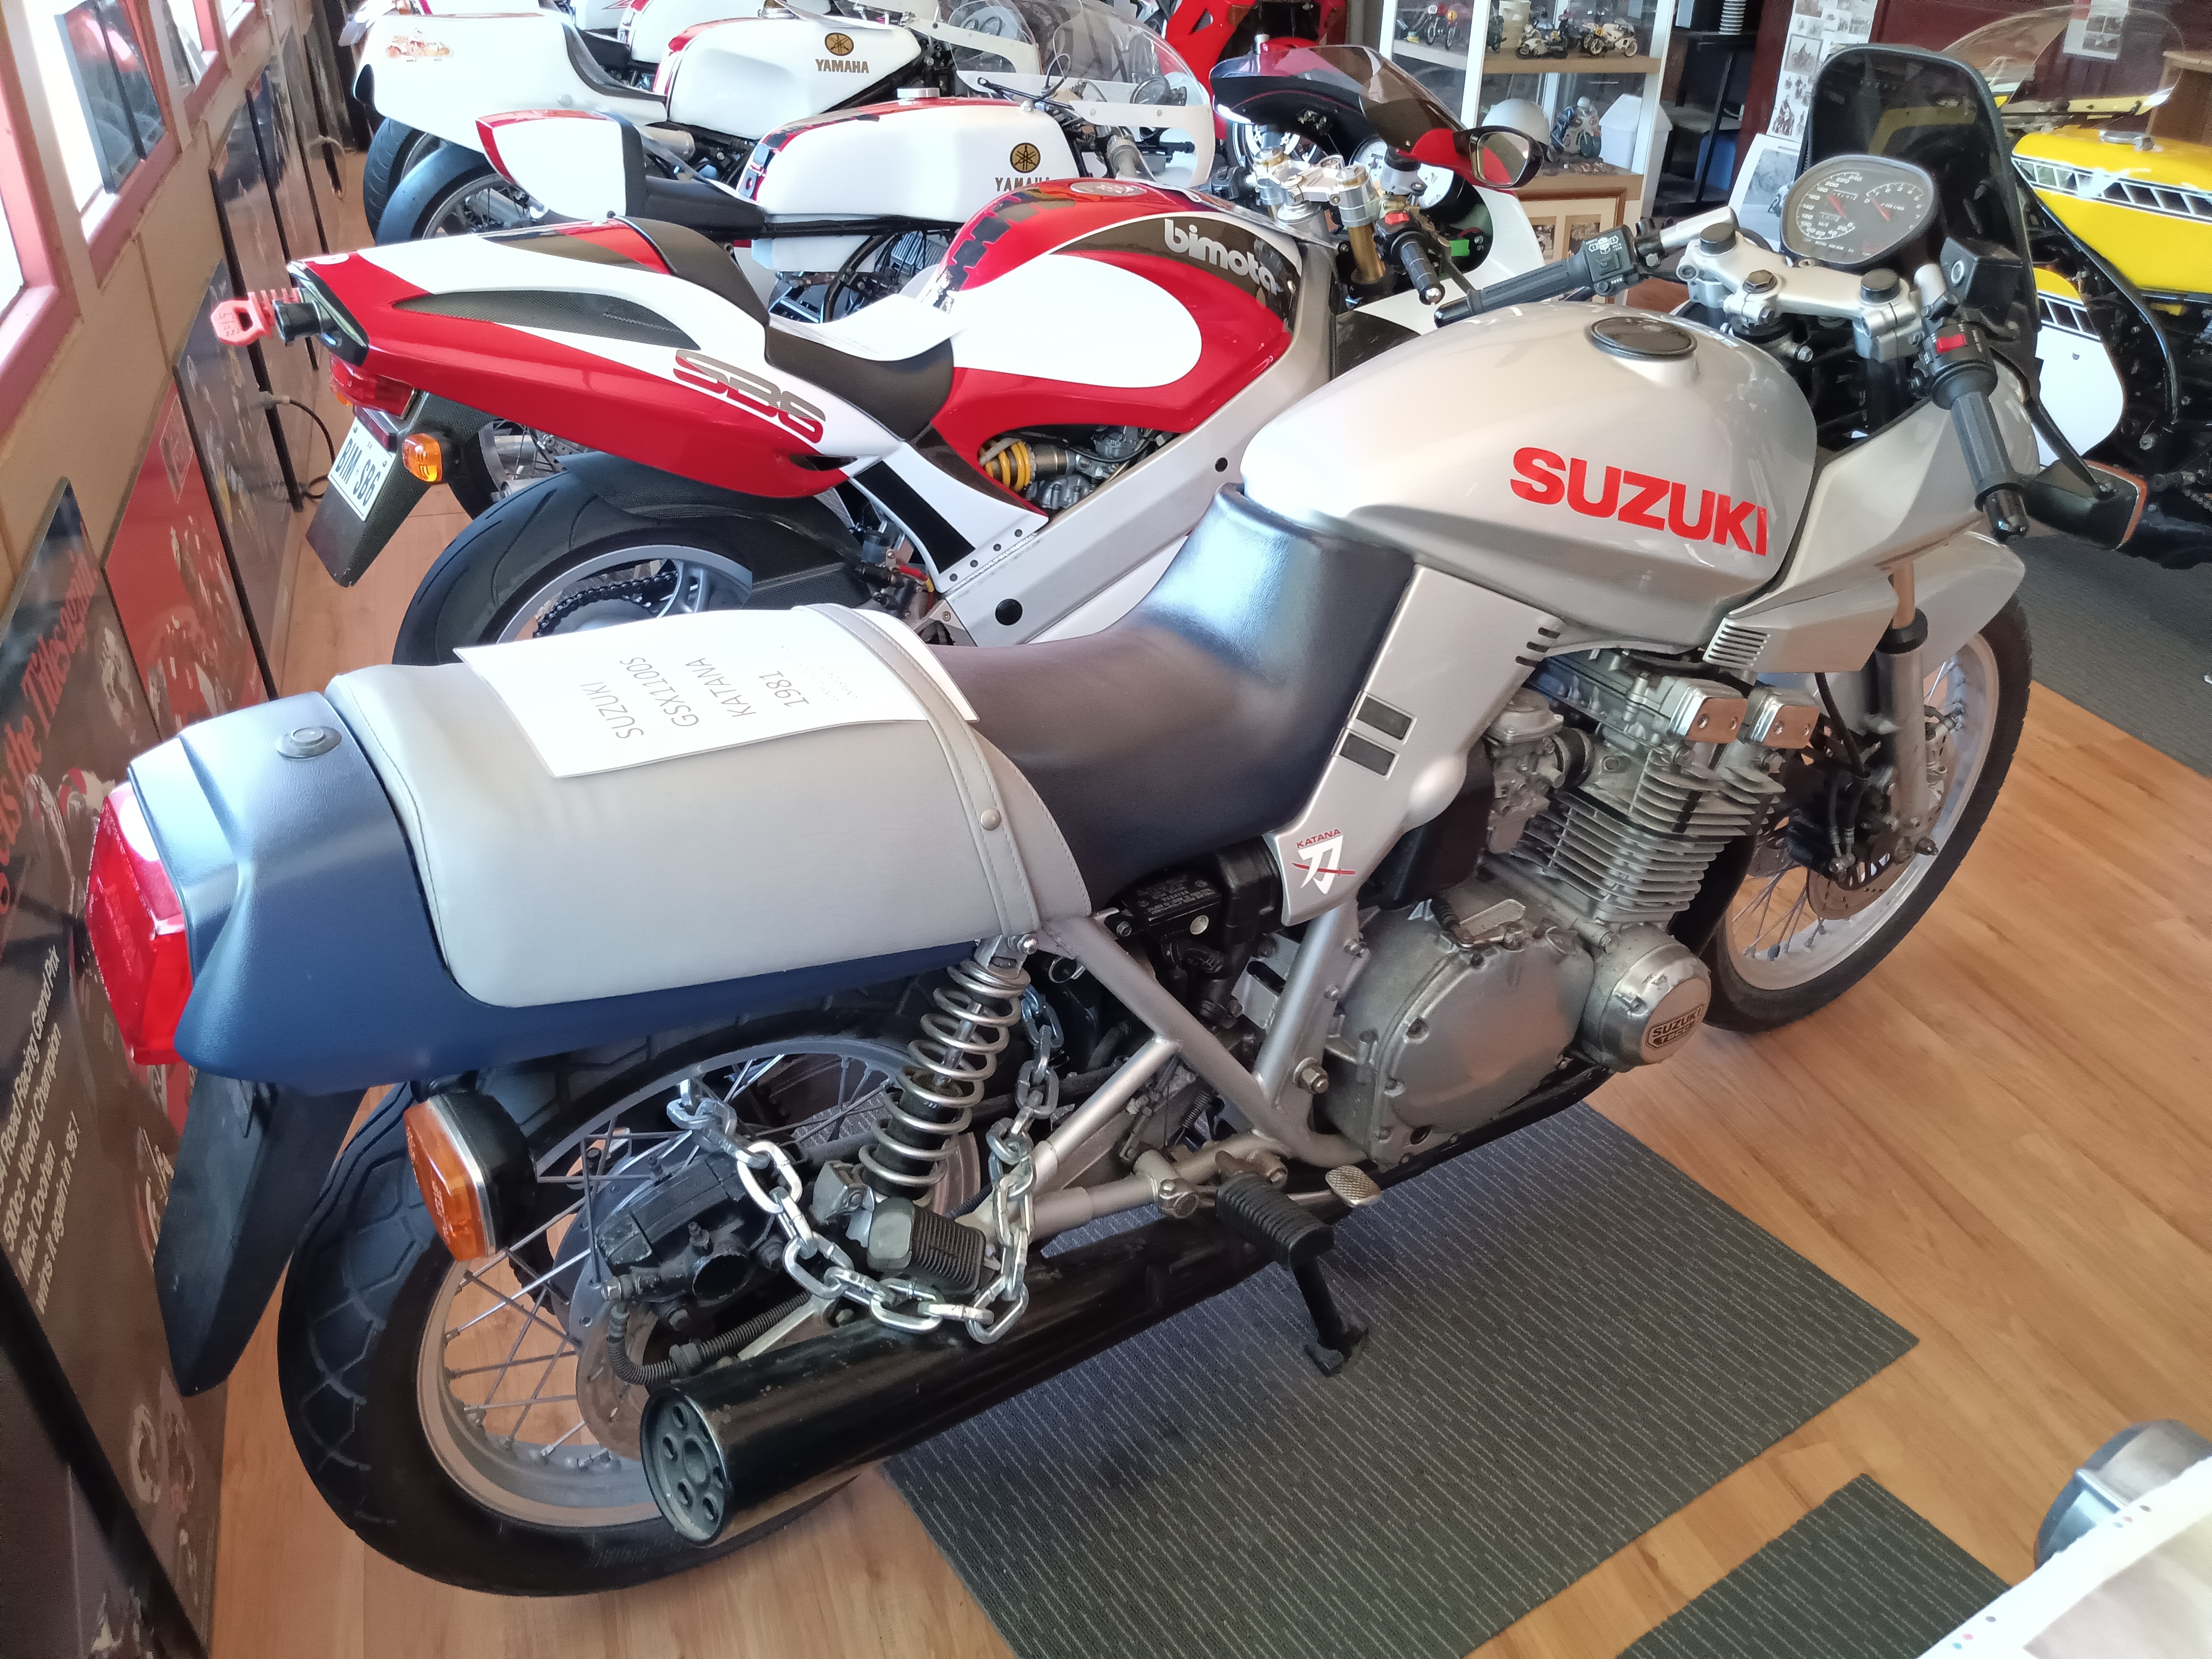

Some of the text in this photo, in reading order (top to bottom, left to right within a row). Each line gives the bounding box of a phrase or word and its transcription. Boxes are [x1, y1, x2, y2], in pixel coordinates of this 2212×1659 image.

[815, 59, 869, 74] YAMAHA
[995, 177, 1050, 192] YAMA
[1165, 218, 1277, 296] bimota
[1510, 447, 1768, 556] SUZUKI
[579, 682, 644, 739] SUZUKI
[619, 657, 699, 727] GSX1100S
[685, 658, 757, 717] KATANA
[758, 671, 810, 707] 1981
[1297, 829, 1341, 848] KATANA
[1652, 1008, 1701, 1037] SUZUKI
[1, 1093, 22, 1166] Road
[14, 1033, 40, 1109] Racing
[31, 972, 51, 1040] Grand
[3, 1178, 26, 1252] 500cc
[18, 1109, 40, 1183] World
[34, 1022, 61, 1122] Champion
[60, 1156, 72, 1185] in
[18, 1140, 56, 1286] Mick Doohan
[51, 1178, 68, 1243] again
[46, 1230, 57, 1261] it
[36, 1253, 53, 1315] wins
